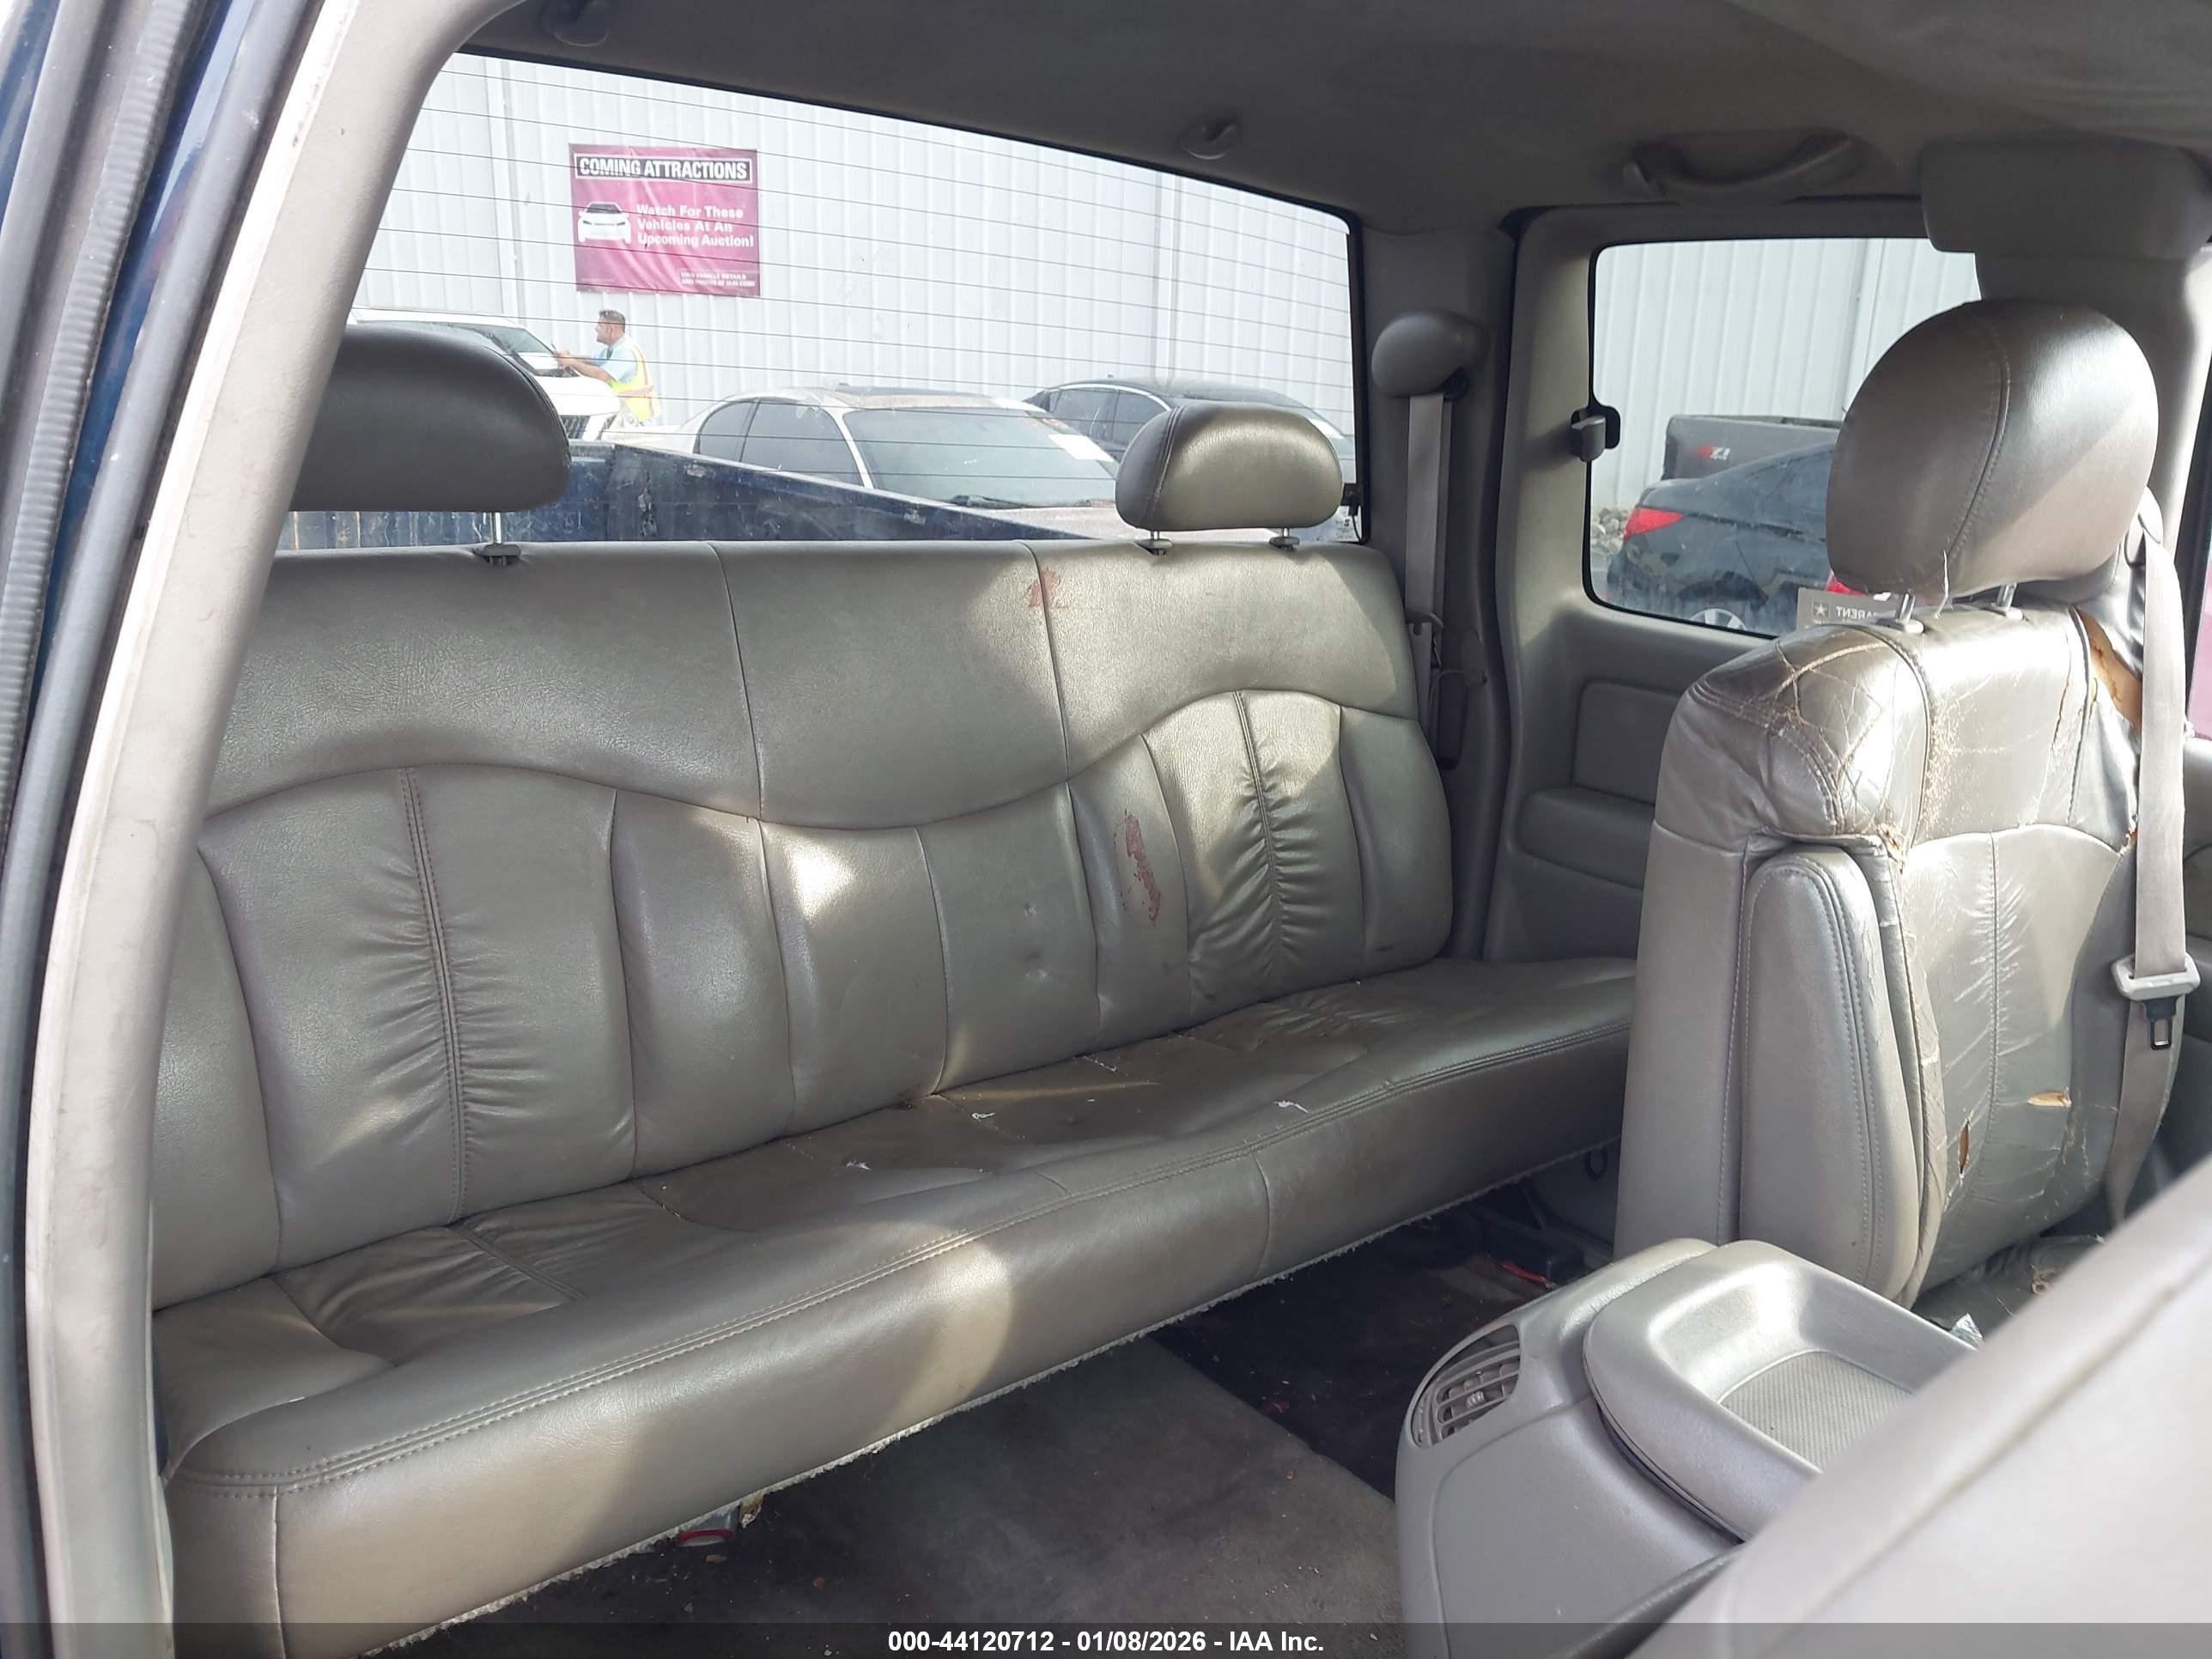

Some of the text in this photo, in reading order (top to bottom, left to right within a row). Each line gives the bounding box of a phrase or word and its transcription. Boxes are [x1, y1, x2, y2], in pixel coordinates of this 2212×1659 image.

[580, 157, 748, 179] COMING ATTRACTIONS
[637, 204, 743, 218] Watch For These
[637, 218, 732, 233] Vehicles At An
[637, 233, 755, 247] Upcoming Auction!
